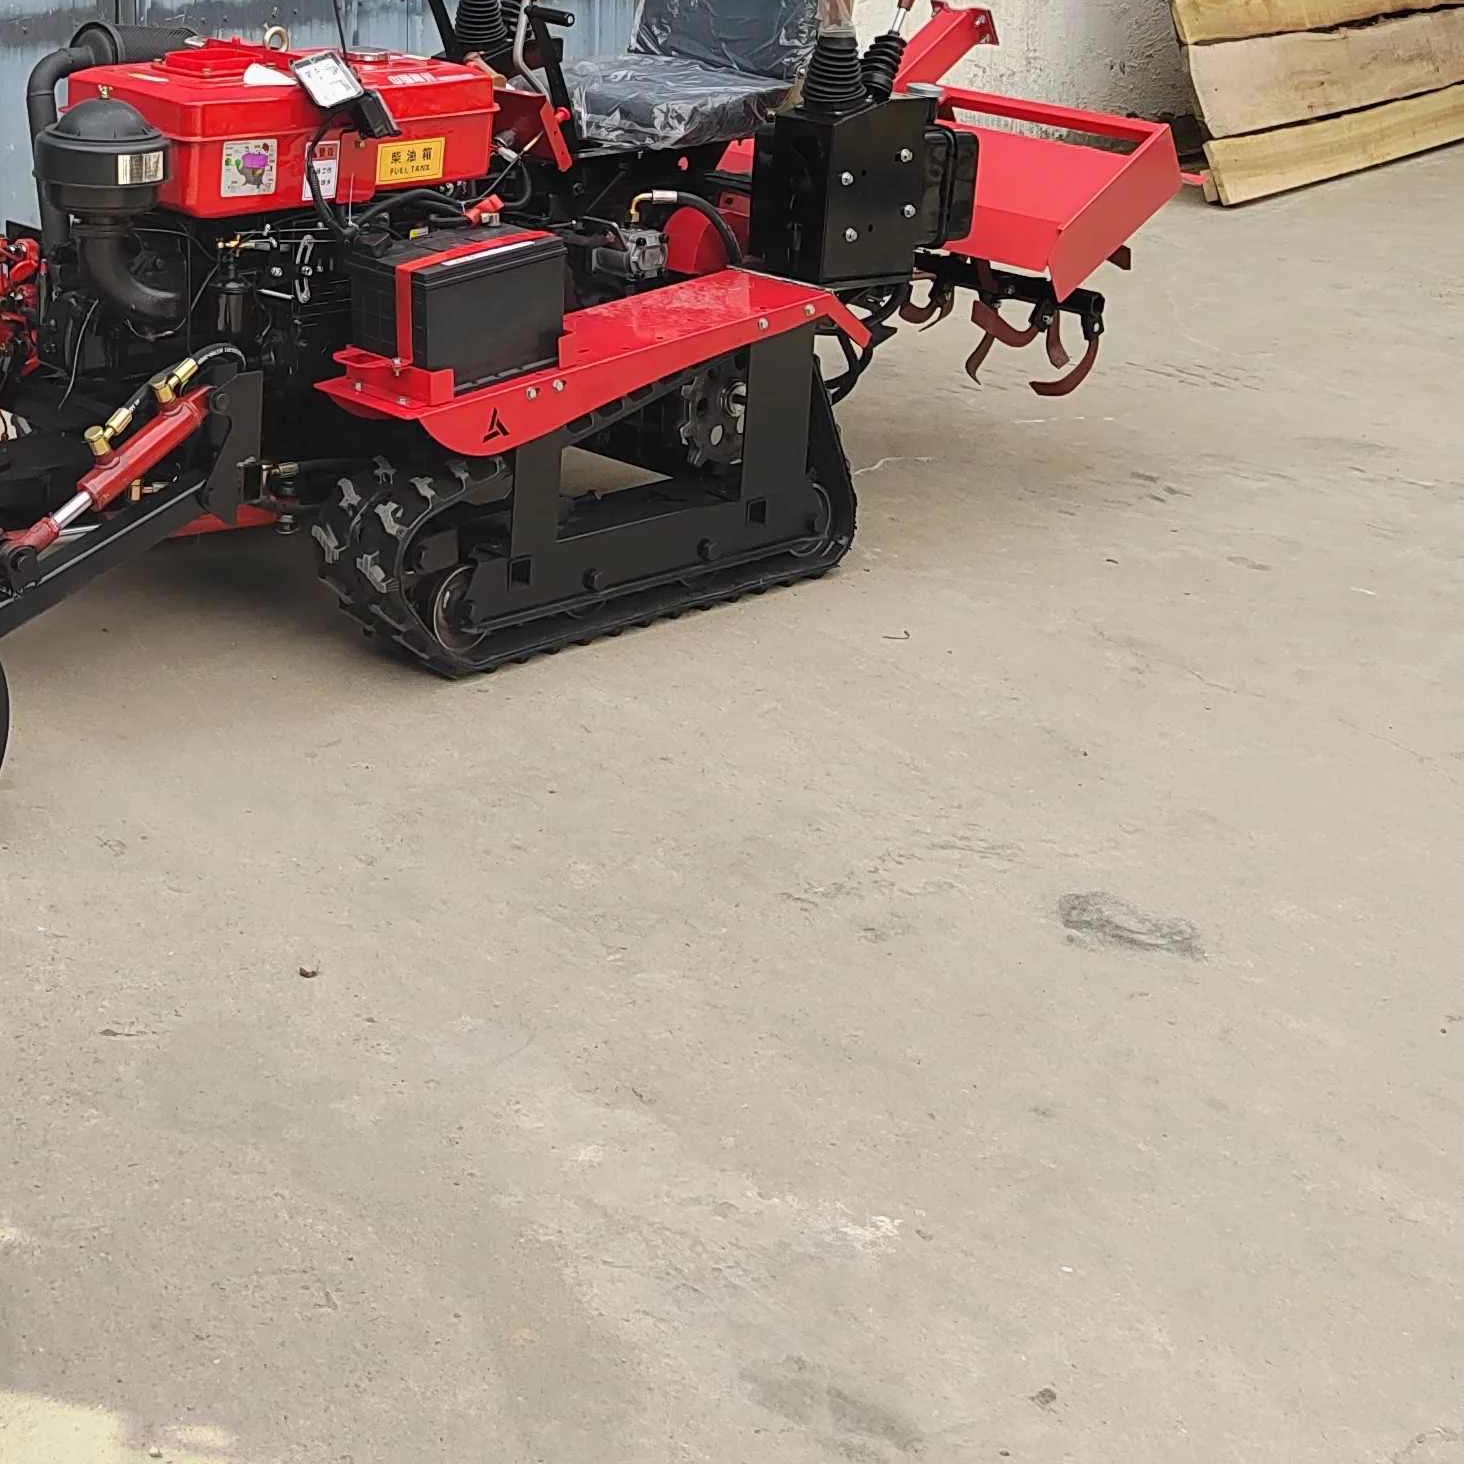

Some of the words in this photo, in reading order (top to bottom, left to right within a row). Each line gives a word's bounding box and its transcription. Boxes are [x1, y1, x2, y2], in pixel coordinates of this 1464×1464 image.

[390, 146, 433, 165] 柴油箱
[389, 167, 408, 176] FUEL
[411, 164, 431, 173] TANK
